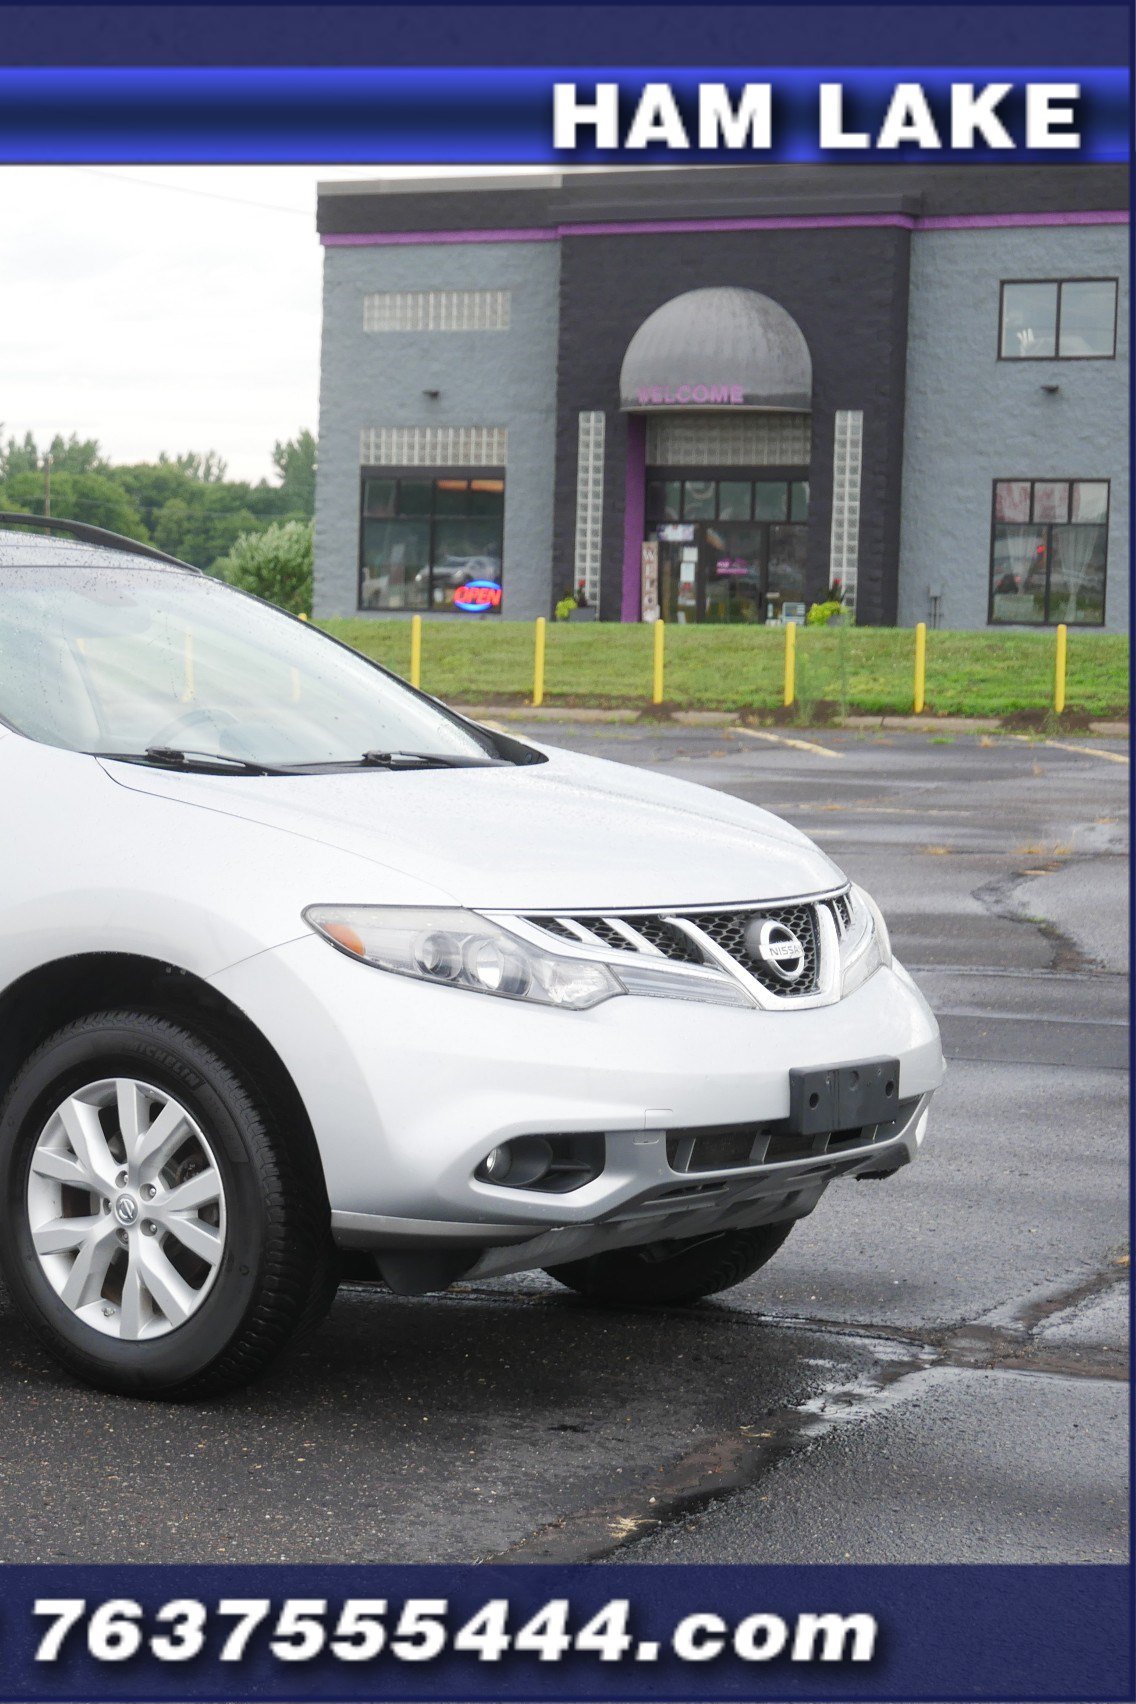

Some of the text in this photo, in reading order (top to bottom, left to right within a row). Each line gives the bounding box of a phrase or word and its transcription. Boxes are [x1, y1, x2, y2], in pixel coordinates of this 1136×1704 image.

[637, 384, 744, 404] WELCOME
[454, 585, 502, 606] OPEN
[769, 944, 803, 956] NISSA
